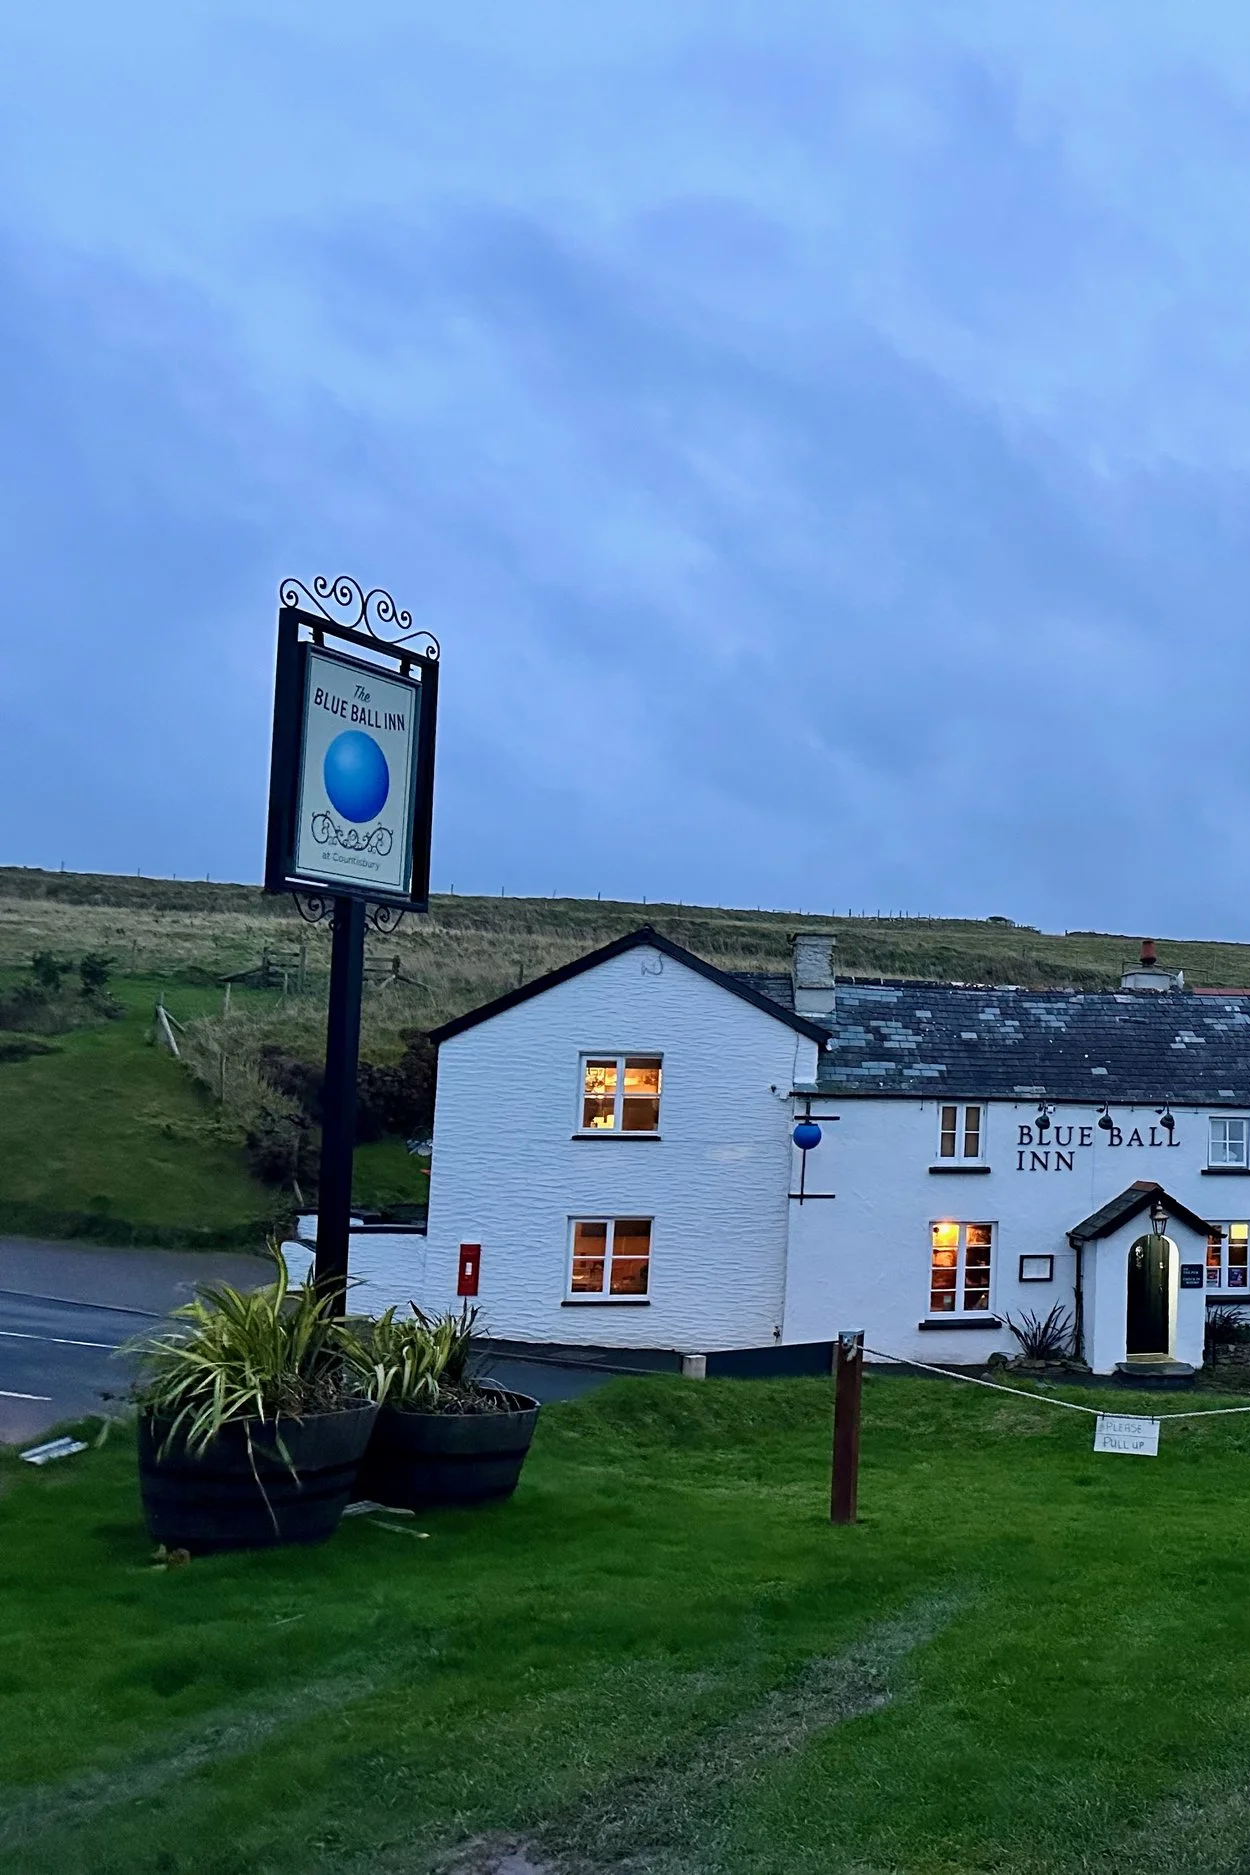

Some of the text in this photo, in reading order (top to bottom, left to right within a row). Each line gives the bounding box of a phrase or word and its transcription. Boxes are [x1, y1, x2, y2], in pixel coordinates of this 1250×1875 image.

[353, 684, 372, 703] The
[313, 687, 405, 731] BLUE BALL INN
[321, 851, 331, 860] at
[1017, 1125, 1181, 1147] BLUE BALL
[1016, 1150, 1076, 1172] INN
[1106, 1421, 1142, 1434] PLEASE
[1103, 1436, 1129, 1450] PULL
